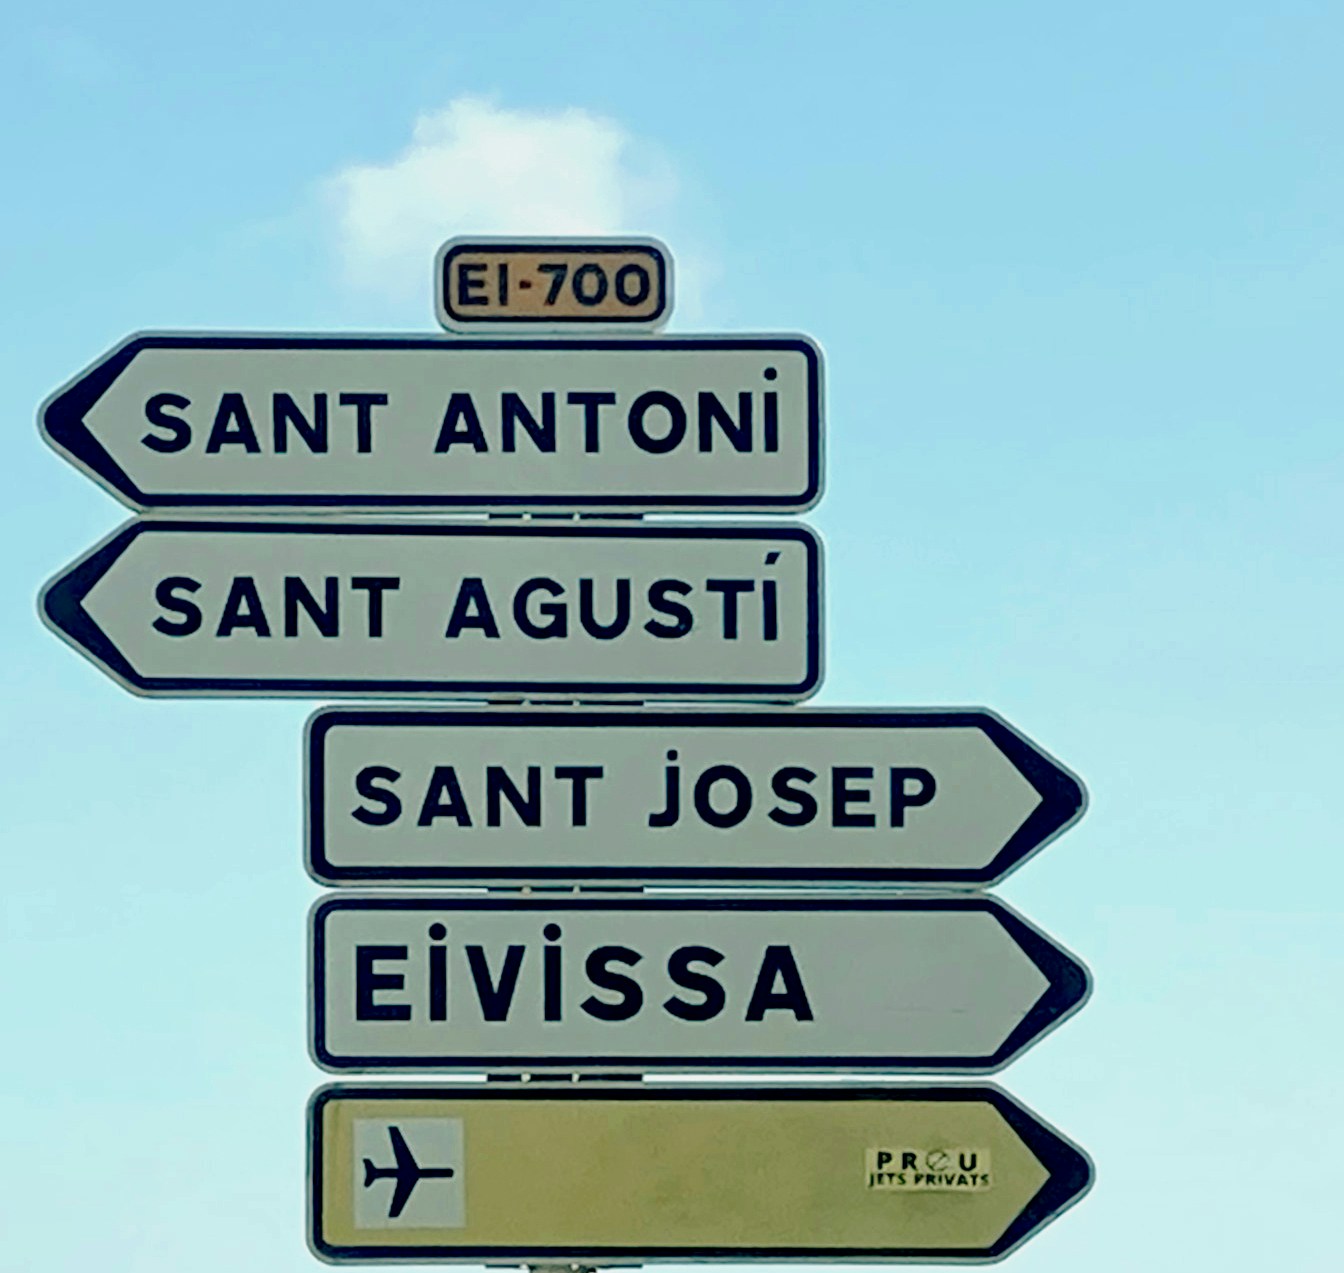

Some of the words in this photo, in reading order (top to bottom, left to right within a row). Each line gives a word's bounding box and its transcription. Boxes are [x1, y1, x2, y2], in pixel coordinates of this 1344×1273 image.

[457, 262, 651, 307] EI-700
[140, 393, 389, 454] SANT
[153, 577, 401, 638] SANT
[446, 552, 781, 641] AGUSTÍ
[352, 766, 604, 828] SANT
[868, 1173, 906, 1187] JETS
[914, 1173, 989, 1186] PRIVATS
